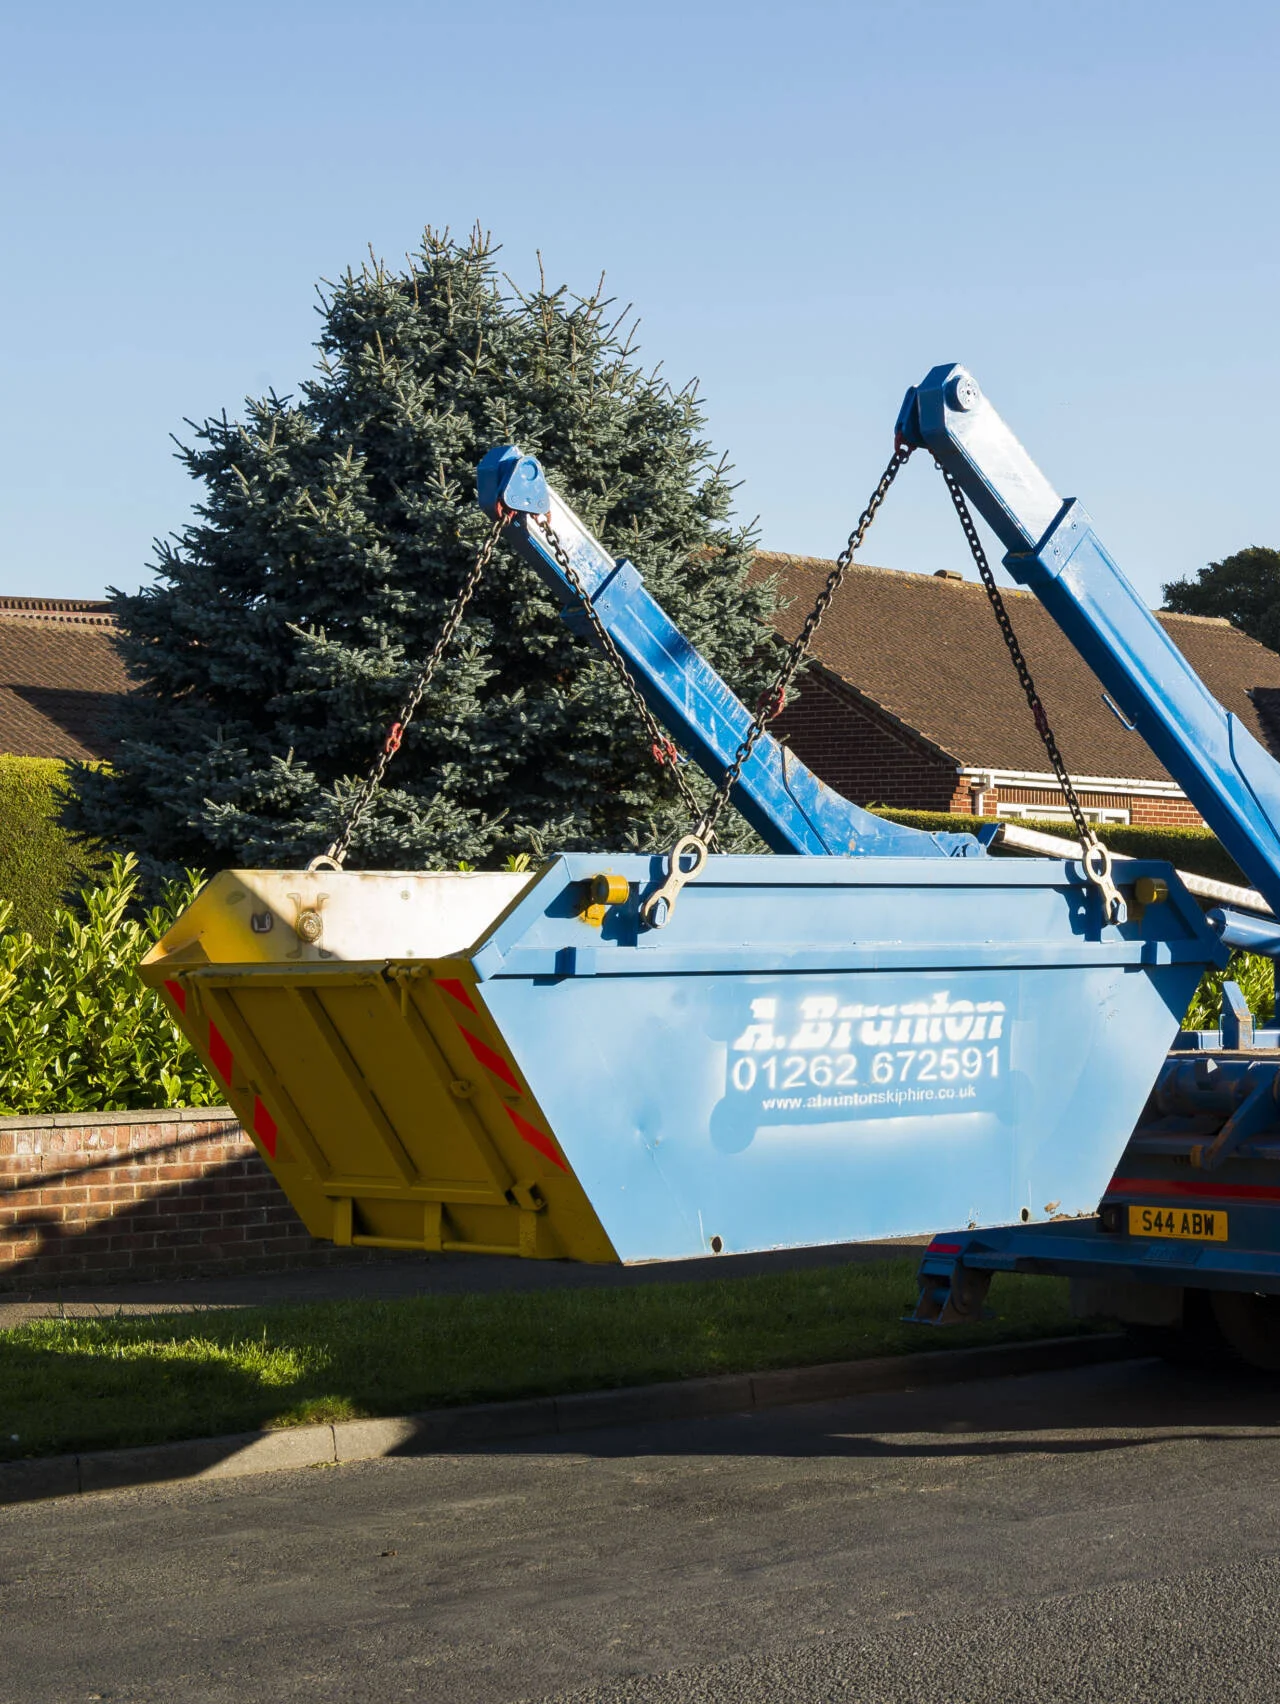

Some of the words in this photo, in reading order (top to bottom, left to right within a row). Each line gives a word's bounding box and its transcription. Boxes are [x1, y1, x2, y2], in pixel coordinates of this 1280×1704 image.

[732, 1053, 858, 1091] 01262
[871, 1046, 1000, 1083] 672591
[762, 1084, 977, 1110] www.abruntonskiphire.co.uk
[1142, 1210, 1175, 1233] S44
[1181, 1213, 1214, 1236] ABW
